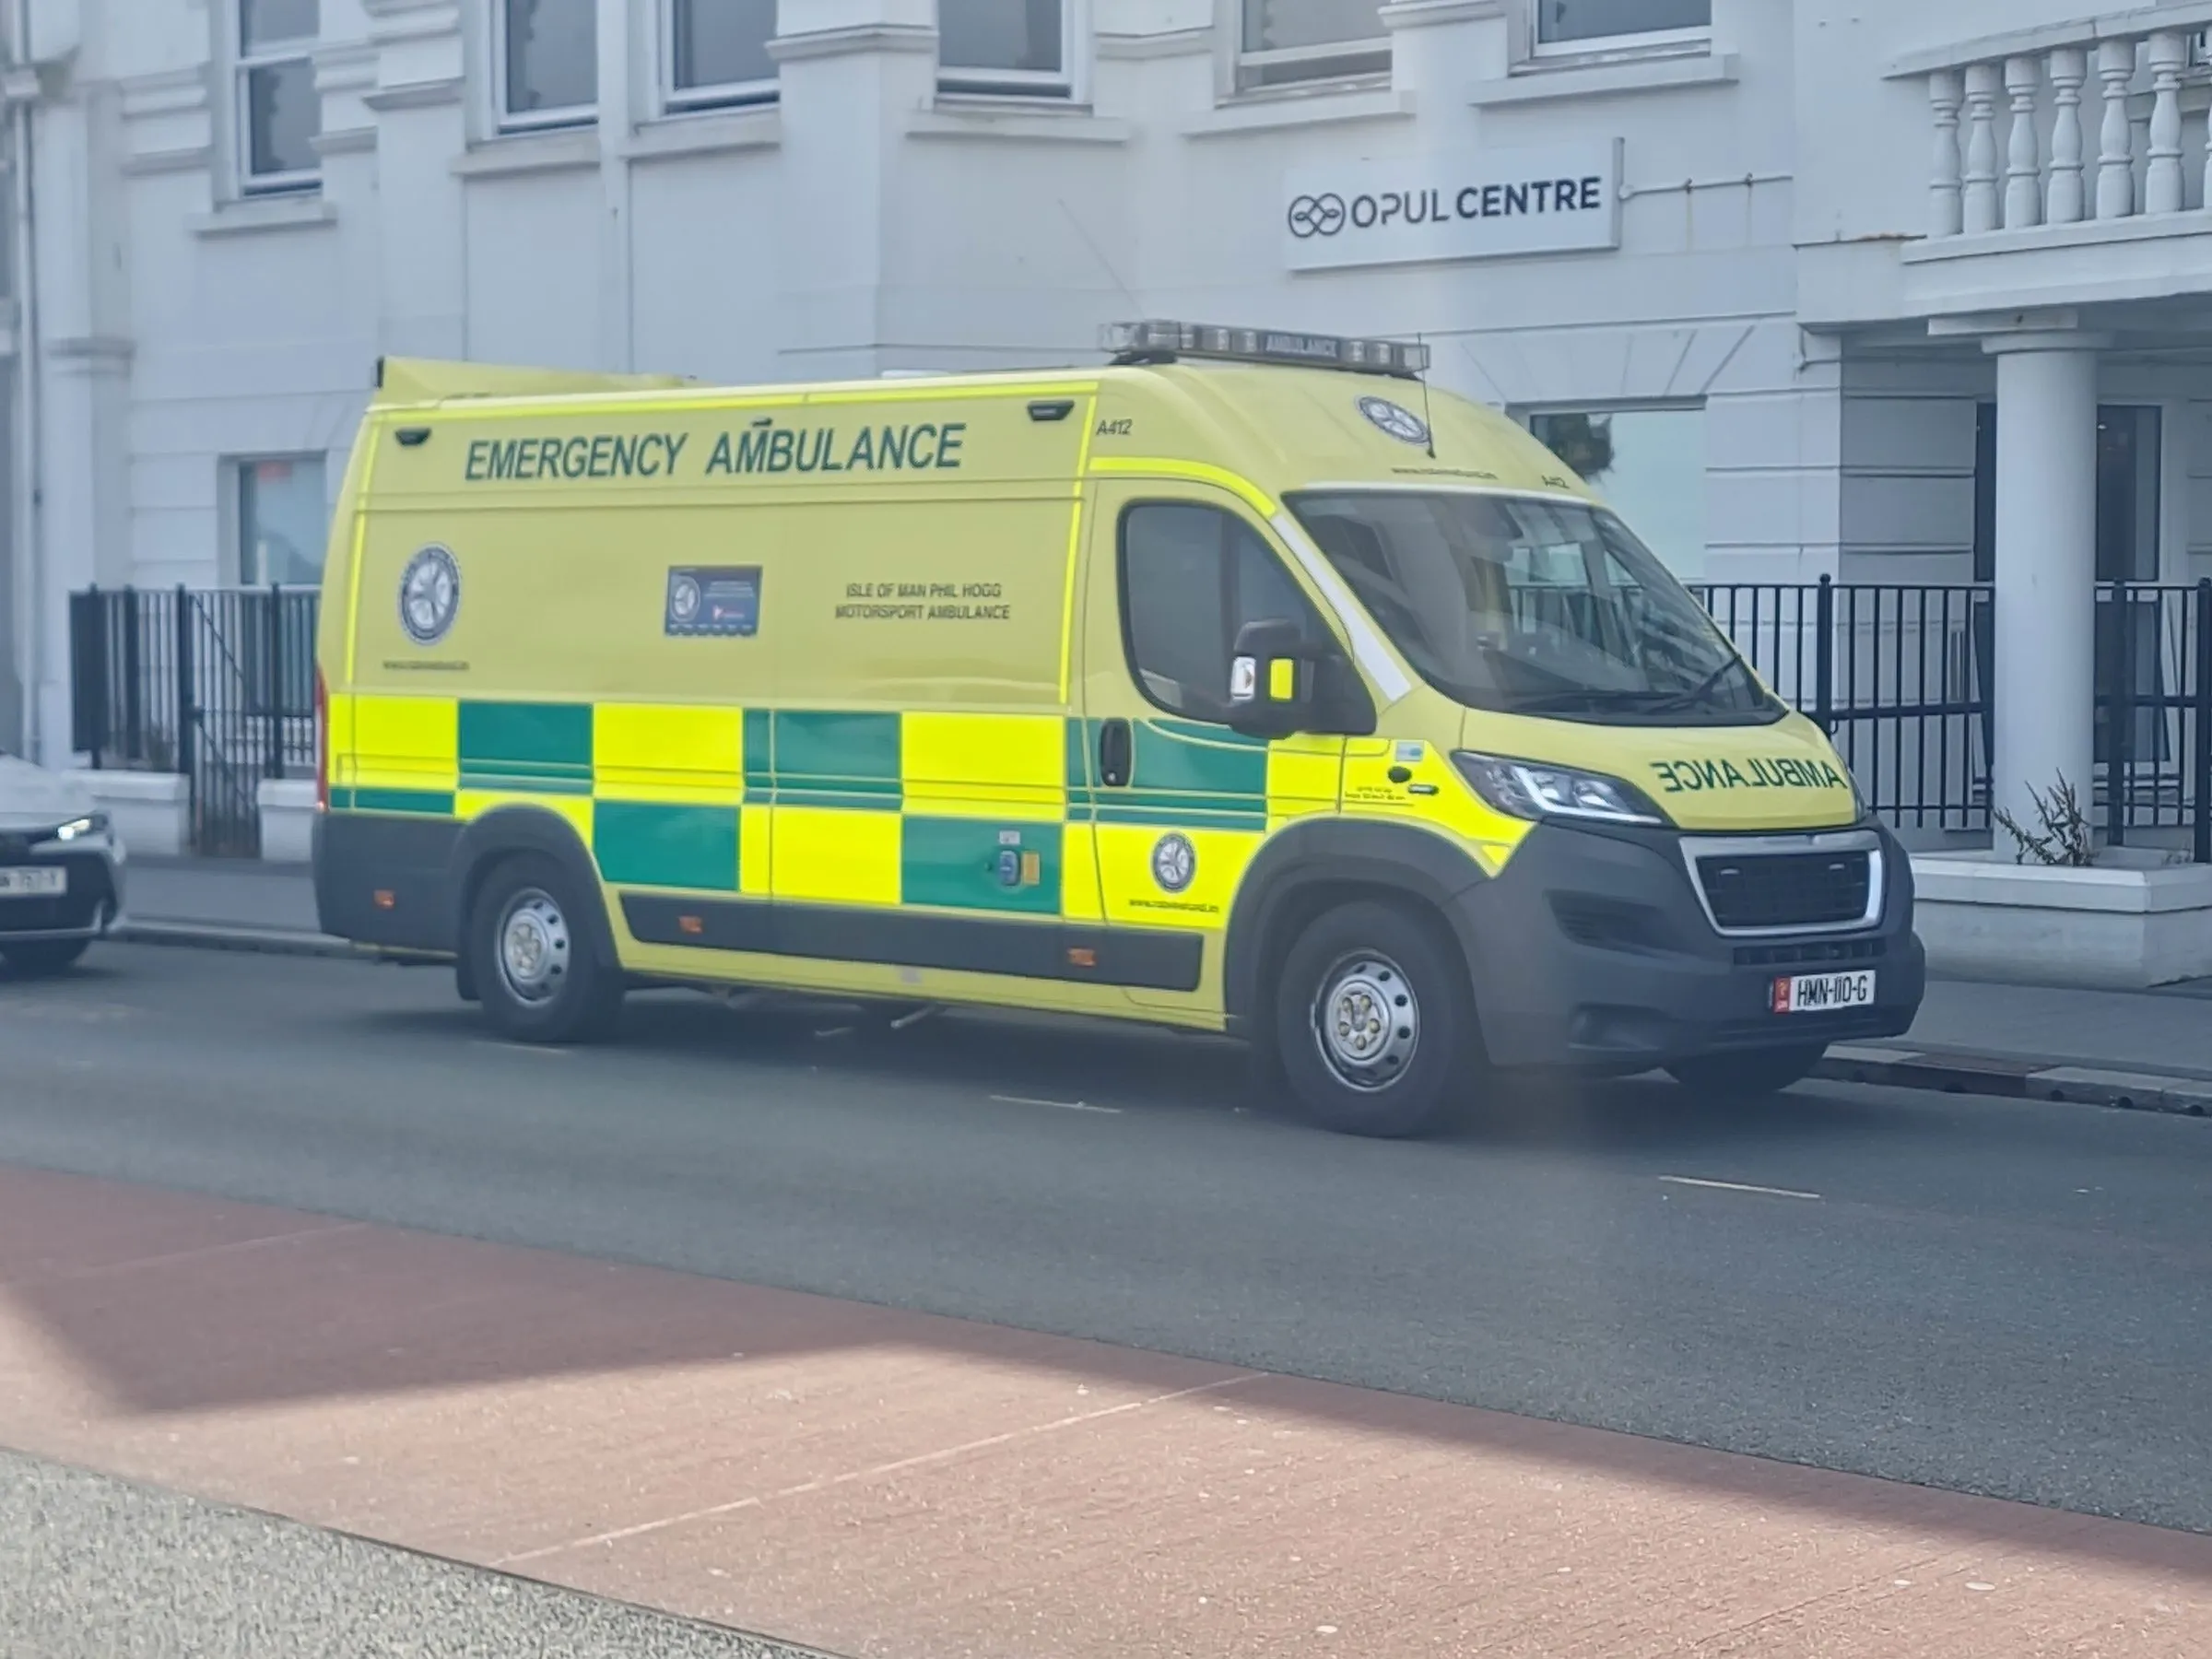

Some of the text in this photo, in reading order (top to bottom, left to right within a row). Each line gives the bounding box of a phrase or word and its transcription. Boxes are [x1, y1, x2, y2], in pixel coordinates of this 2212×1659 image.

[1351, 176, 1602, 229] OPUL CENTRE
[1095, 418, 1133, 436] A412
[465, 419, 967, 481] EMERGENCY AMBULANCE
[845, 582, 874, 598] ISLE
[877, 582, 895, 598] OF
[897, 582, 926, 598] MAN
[962, 582, 1002, 598] HOGG
[835, 605, 1011, 620] MOTORSPORT AMBULANCE
